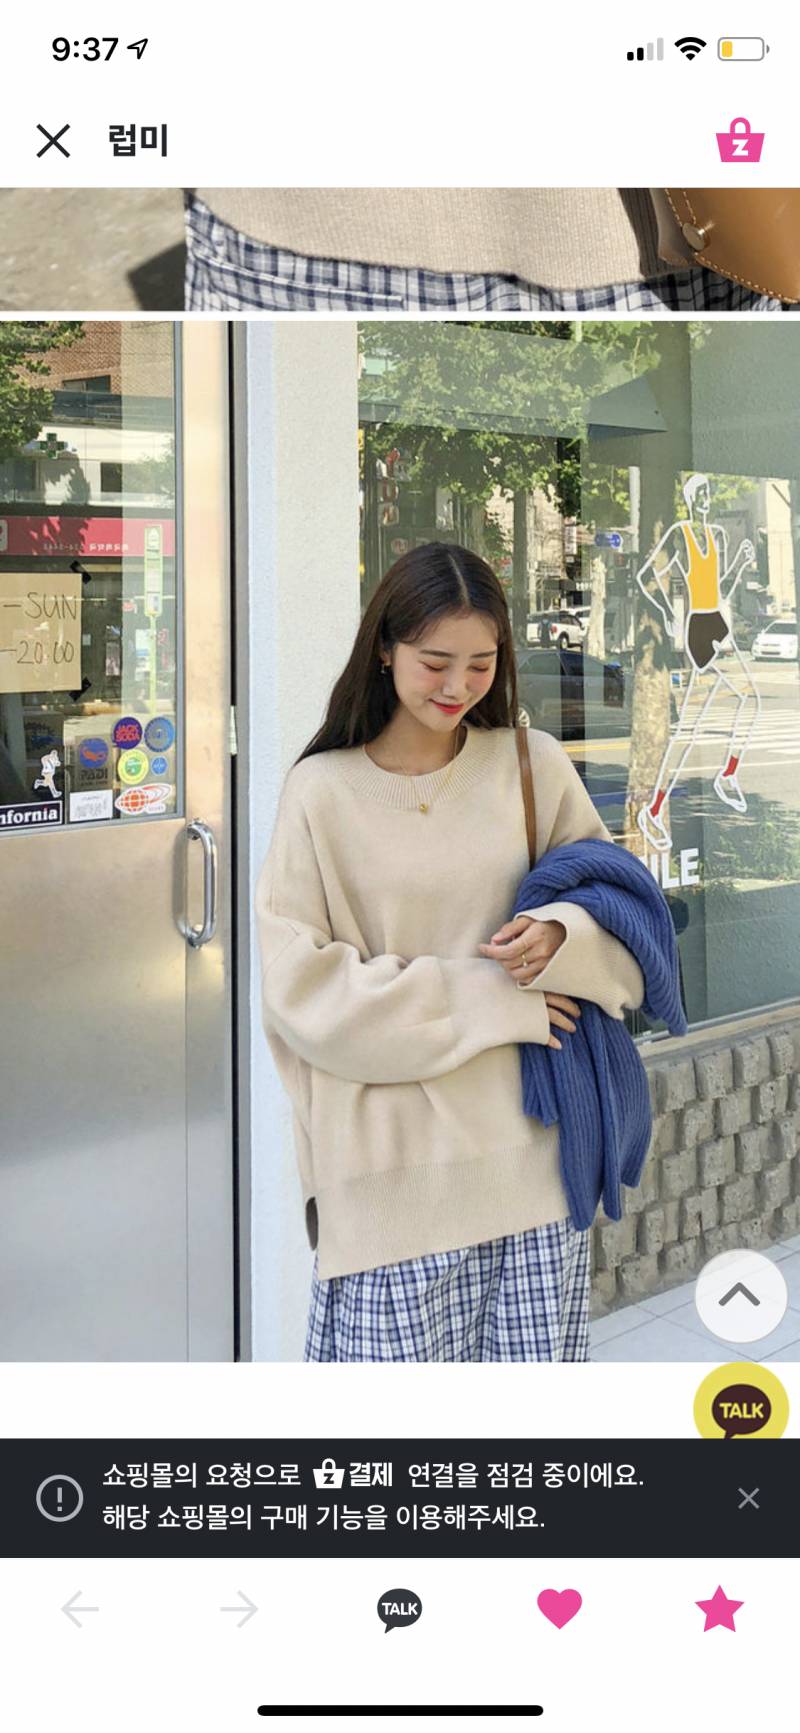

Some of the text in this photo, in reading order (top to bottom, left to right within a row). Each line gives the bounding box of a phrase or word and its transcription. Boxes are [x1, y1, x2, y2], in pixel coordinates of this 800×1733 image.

[51, 37, 119, 61] 9:37
[108, 123, 168, 157] 럽미
[639, 847, 700, 889] ILE
[719, 1402, 764, 1419] TALK
[102, 1462, 197, 1489] 쇼핑몰의
[205, 1462, 302, 1489] 요청으로
[348, 1462, 393, 1488] 결제
[408, 1462, 480, 1489] 연결을
[486, 1462, 533, 1489] 점검
[541, 1462, 644, 1489] 중이에요.
[102, 1504, 545, 1531] 해당 쇼핑몰의 구매 기능을 이용해주세요.
[381, 1601, 418, 1617] TALK
